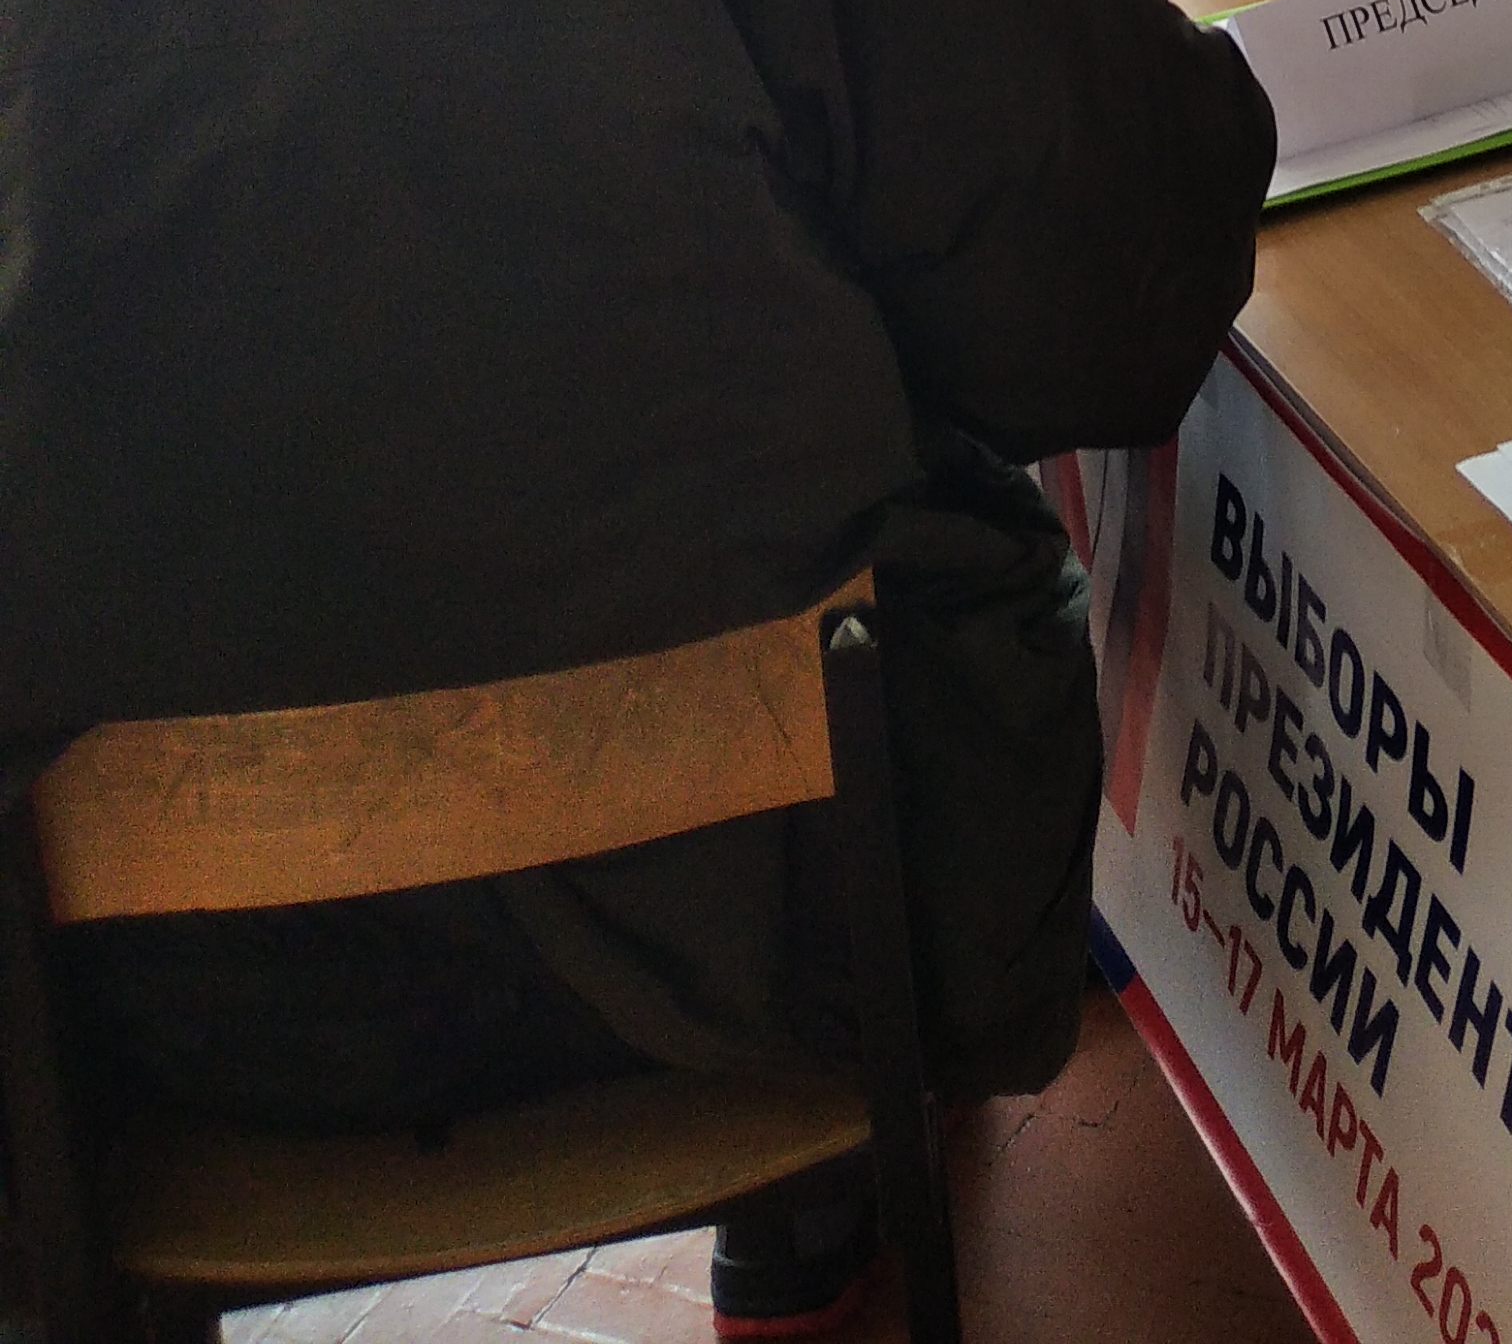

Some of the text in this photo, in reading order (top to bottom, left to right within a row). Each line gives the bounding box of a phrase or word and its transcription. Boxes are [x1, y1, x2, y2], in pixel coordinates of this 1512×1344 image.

[1210, 473, 1476, 875] ВЫБОРЫ
[1180, 719, 1402, 1099] РОССИИ
[1268, 985, 1398, 1261] МАРТА
